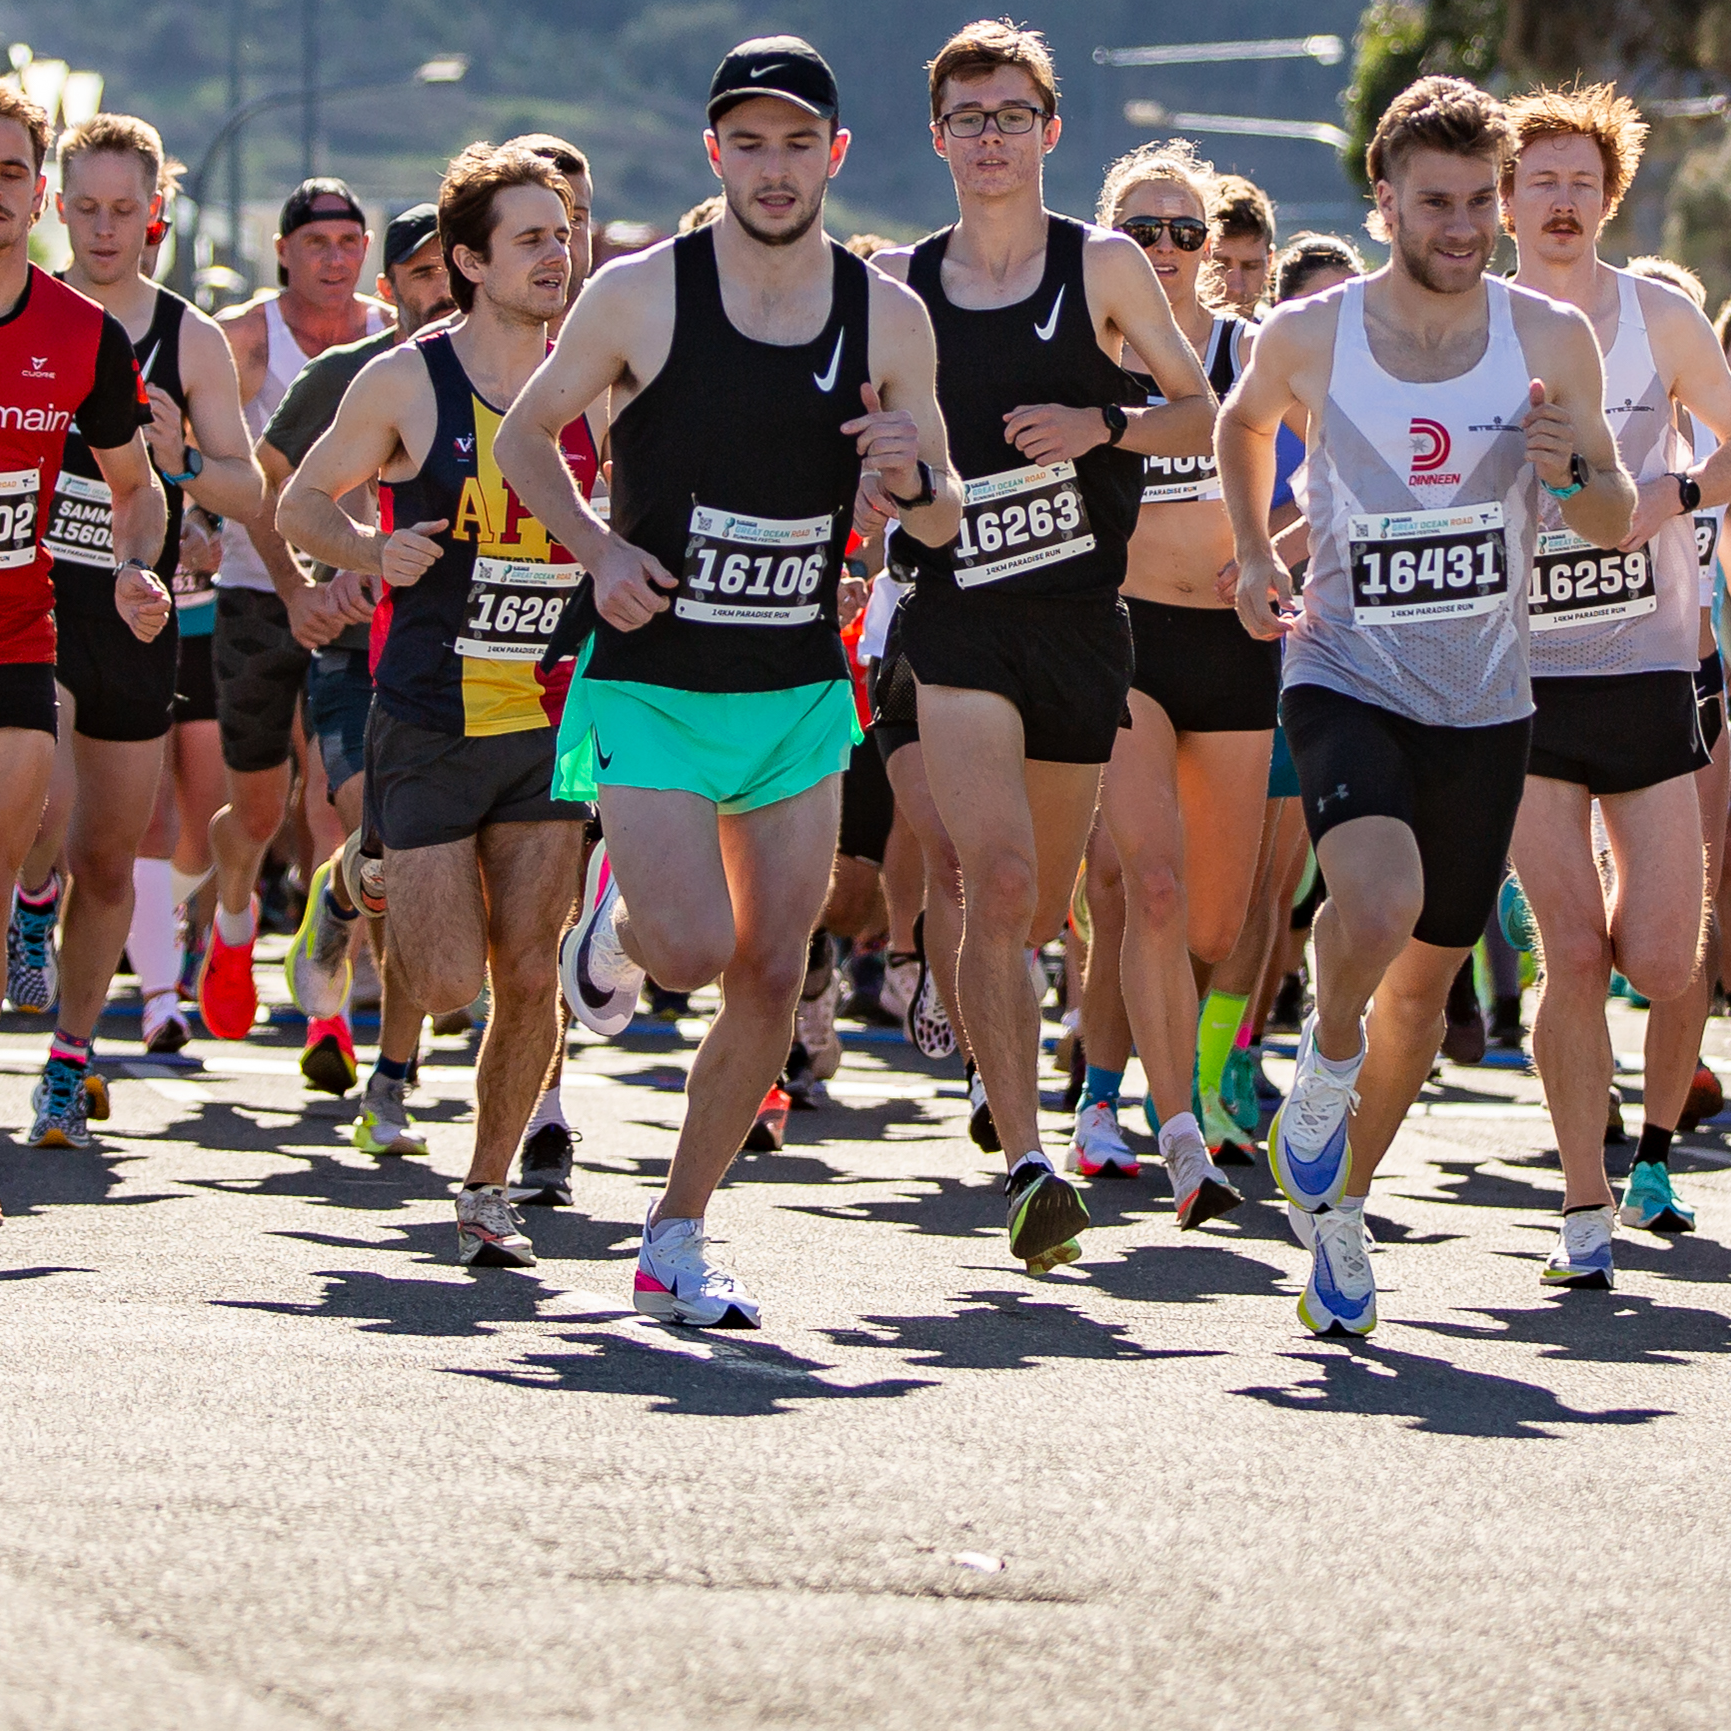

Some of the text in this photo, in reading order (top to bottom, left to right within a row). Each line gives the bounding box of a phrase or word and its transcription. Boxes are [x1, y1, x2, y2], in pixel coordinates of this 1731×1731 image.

[21, 370, 56, 379] CUORE
[972, 471, 1046, 496] GREAT OCEAN ROAD
[1408, 473, 1461, 486] DINNEEN
[1148, 484, 1198, 497] PARADISE RUN
[59, 500, 113, 526] SAMM
[734, 526, 811, 538] GREAT OCEAN ROAD
[956, 491, 1080, 559] 16263
[1391, 516, 1474, 532] GREAT OCEAN ROAD
[1548, 537, 1572, 548] GREAT
[986, 548, 1061, 576] 14KM PARADISE RUN
[1361, 541, 1500, 595] 16431
[689, 549, 823, 597] 16106
[1528, 552, 1647, 605] 16259
[469, 594, 570, 634] 1628
[735, 609, 773, 618] PARADISE
[773, 610, 791, 619] RUN
[1391, 603, 1474, 618] 14KM PARADISE RUN
[1553, 606, 1626, 624] 14KM PARADISE RUN
[506, 646, 536, 655] PARADISE
